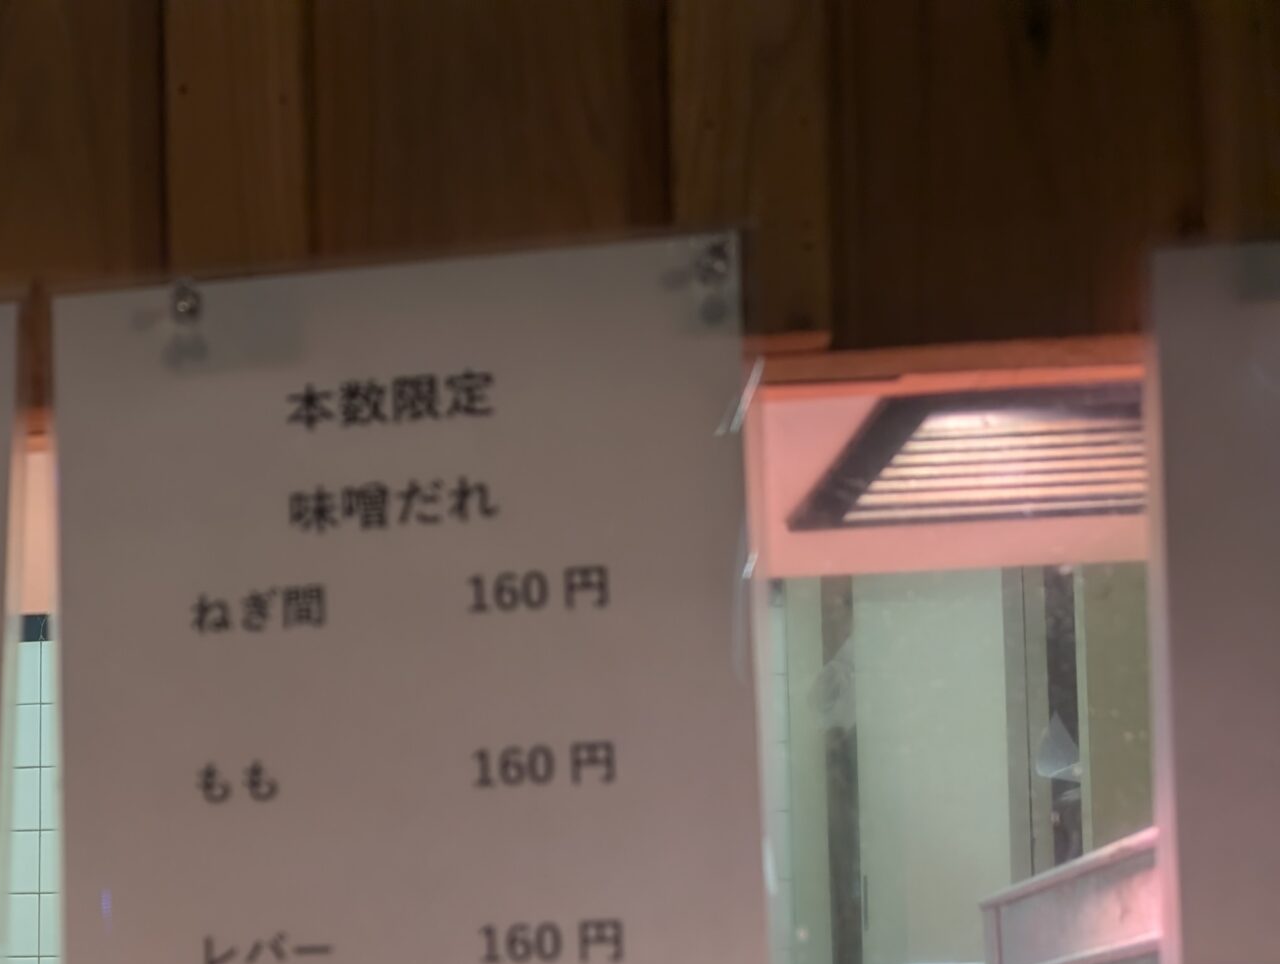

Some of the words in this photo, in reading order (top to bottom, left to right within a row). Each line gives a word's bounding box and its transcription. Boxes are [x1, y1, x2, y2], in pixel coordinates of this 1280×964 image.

[285, 368, 496, 433] 本数限定
[286, 474, 501, 535] 味噌だれ
[189, 581, 329, 636] ねぎ間
[467, 563, 611, 616] 160円
[195, 759, 281, 807] もも
[471, 739, 618, 790] 160円
